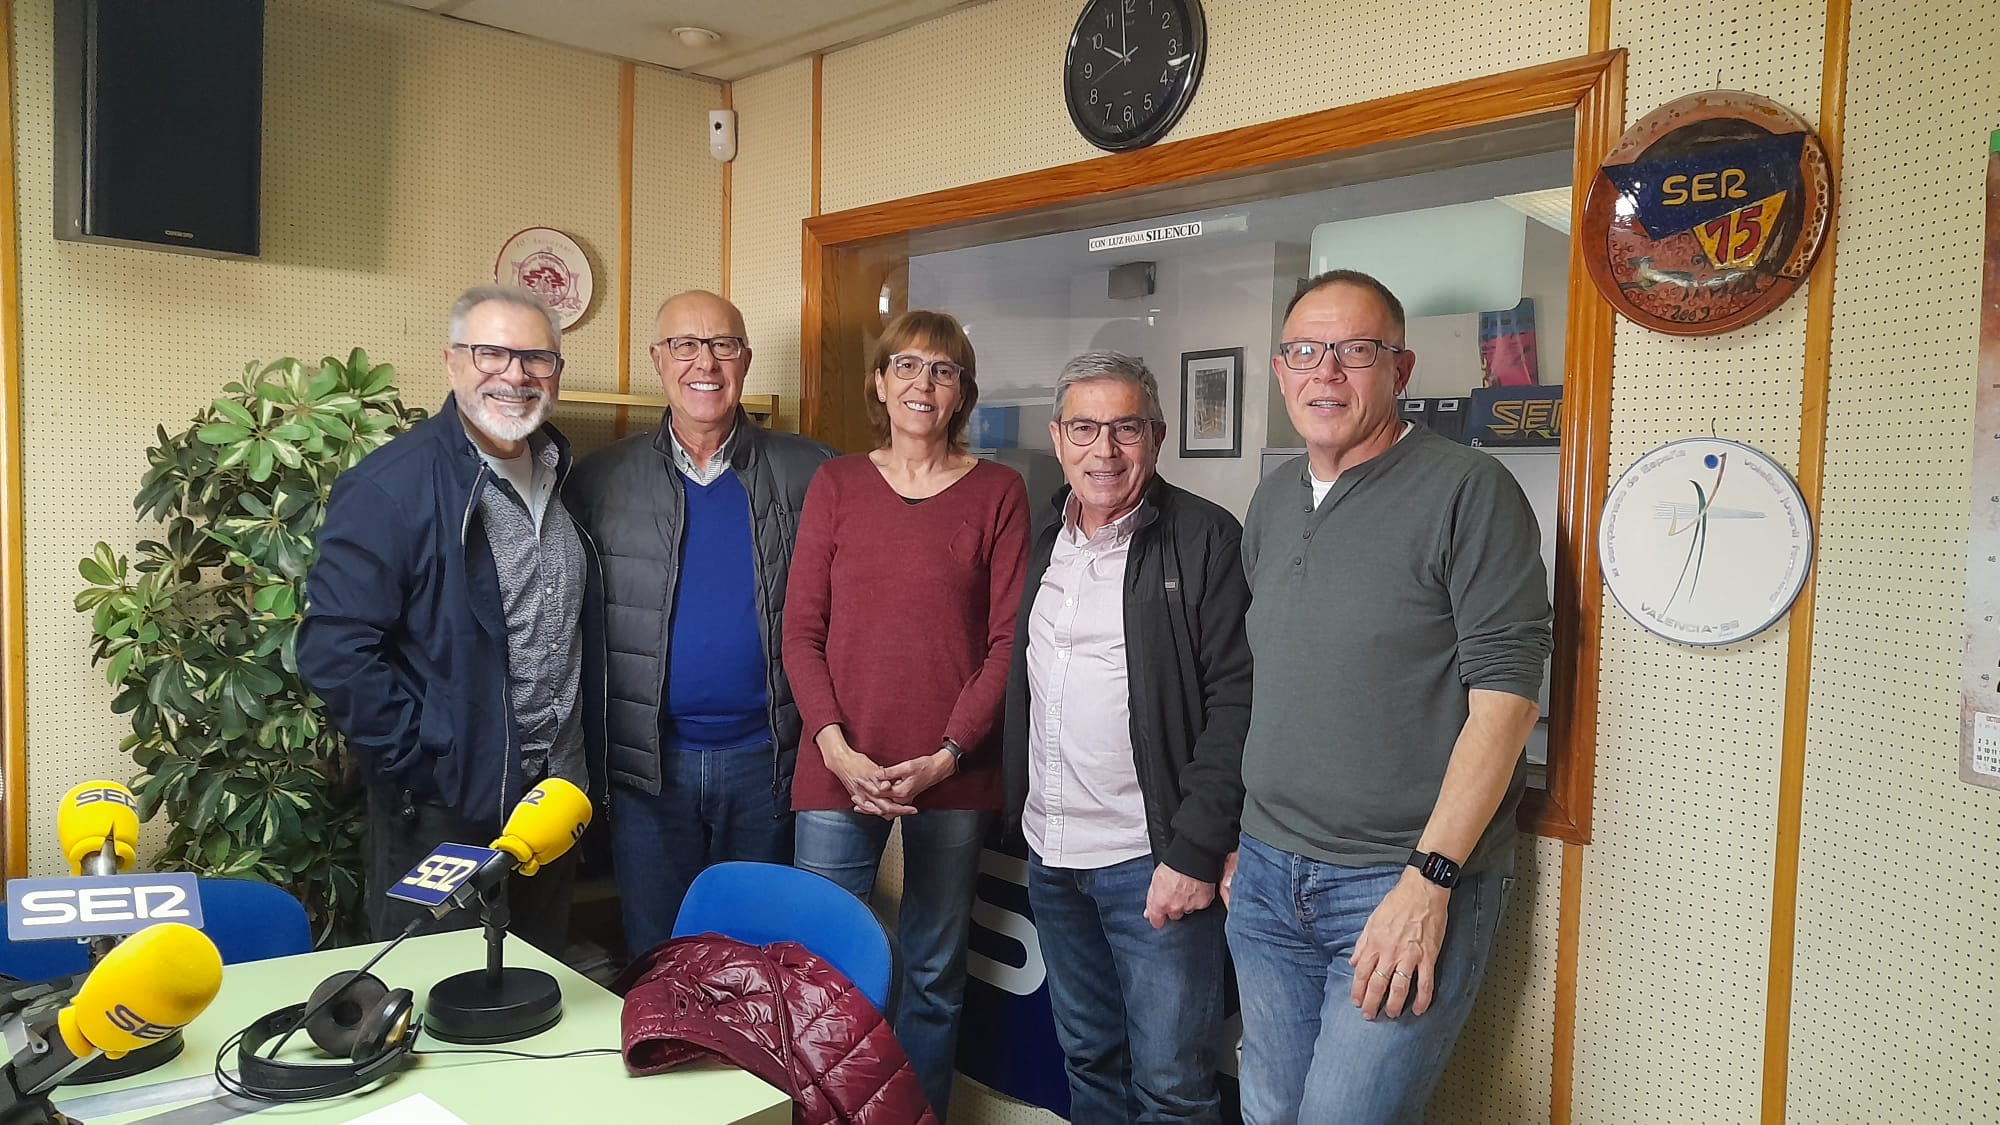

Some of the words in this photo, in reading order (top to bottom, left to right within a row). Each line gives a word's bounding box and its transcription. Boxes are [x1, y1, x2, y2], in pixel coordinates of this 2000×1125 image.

[1105, 13, 1114, 29] 11
[1161, 12, 1171, 29] 2
[1092, 33, 1103, 50] 10
[1168, 39, 1177, 55] 3
[1084, 63, 1093, 79] 9
[1160, 69, 1168, 85] 4
[1090, 89, 1097, 105] 8
[1143, 93, 1151, 110] 5
[1105, 103, 1112, 120] 7
[1123, 105, 1131, 122] 6
[1661, 168, 1748, 206] SER
[1090, 238, 1106, 249] CON
[1108, 236, 1124, 246] LUZ
[1124, 234, 1145, 244] ROJA
[1146, 223, 1200, 242] SILENCIO
[402, 854, 478, 893] SER
[21, 885, 190, 926] SER
[105, 1004, 175, 1039] SE
